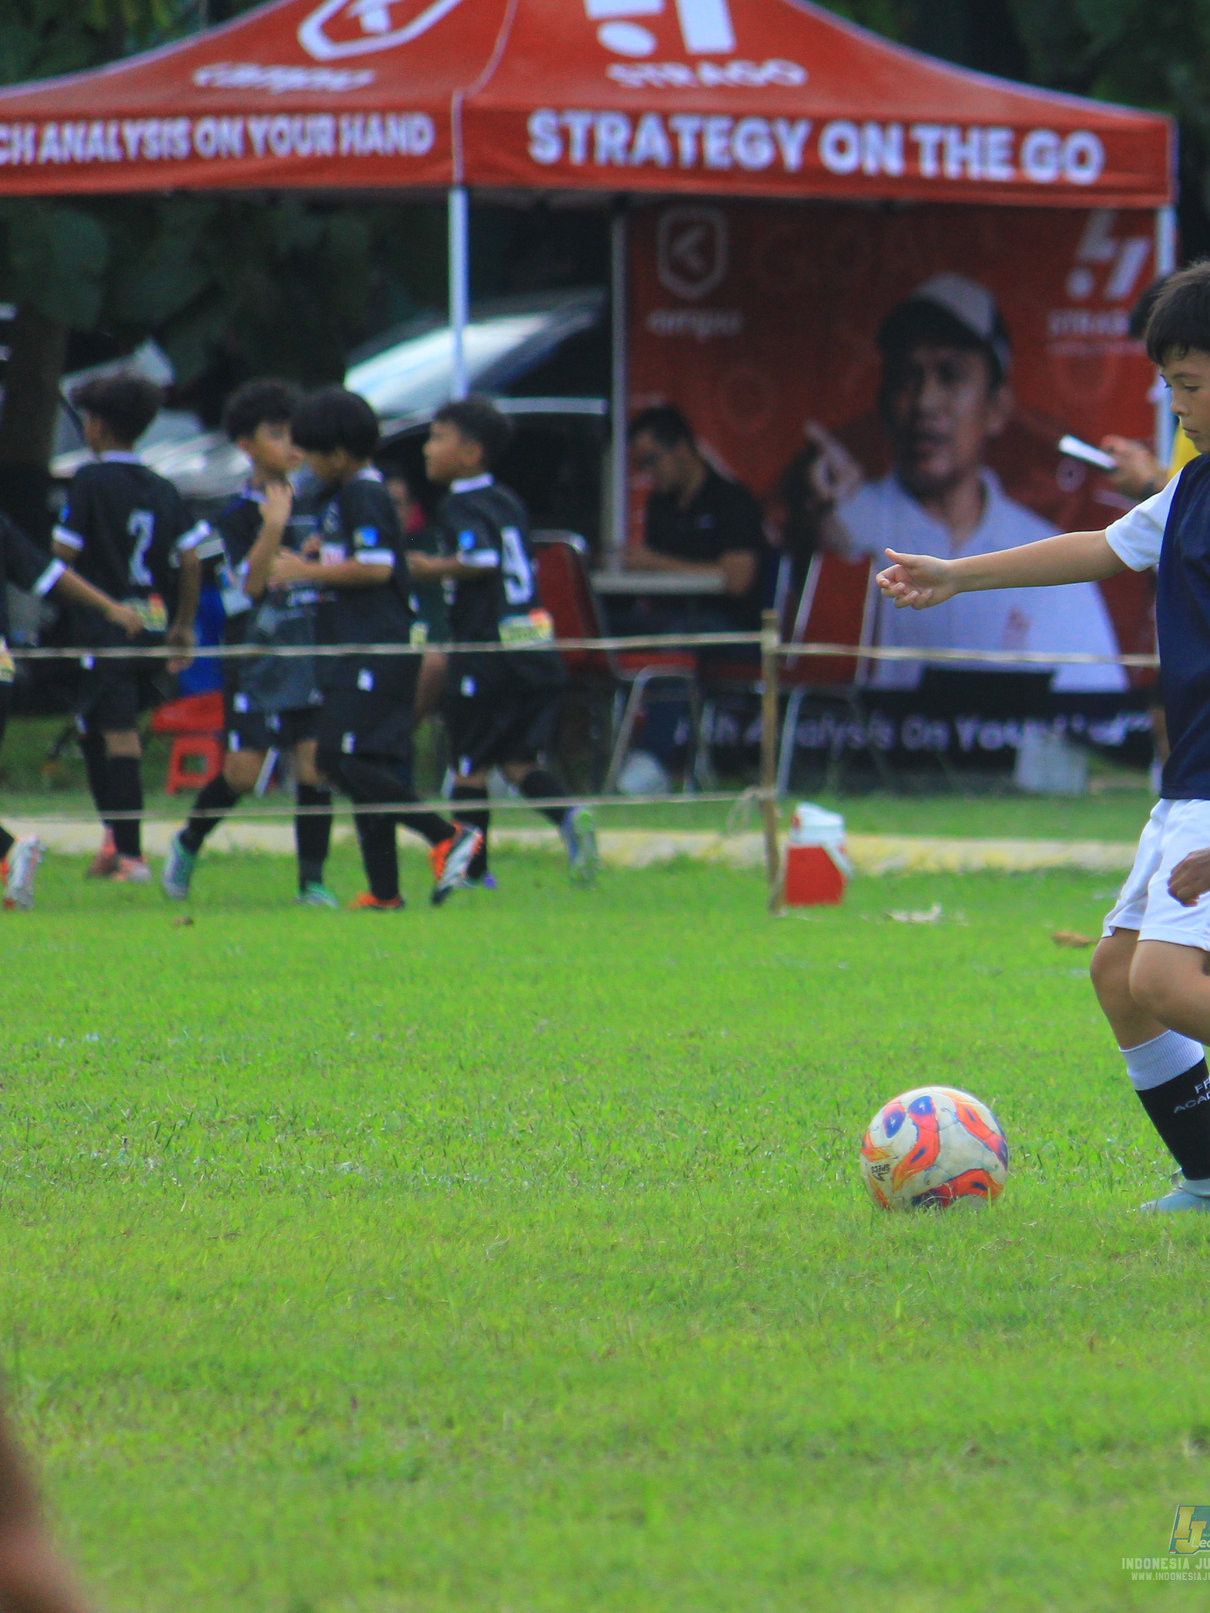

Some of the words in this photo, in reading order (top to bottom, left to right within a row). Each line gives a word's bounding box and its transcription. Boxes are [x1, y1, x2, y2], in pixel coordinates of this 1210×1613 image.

[38, 116, 191, 164] ANALYSIS
[194, 115, 245, 159] ON
[248, 113, 336, 157] YOUR
[339, 111, 435, 157] HAND
[527, 108, 813, 171] STRATEGY
[818, 118, 905, 176] ON
[909, 122, 1015, 182] THE
[1020, 128, 1106, 186] GO
